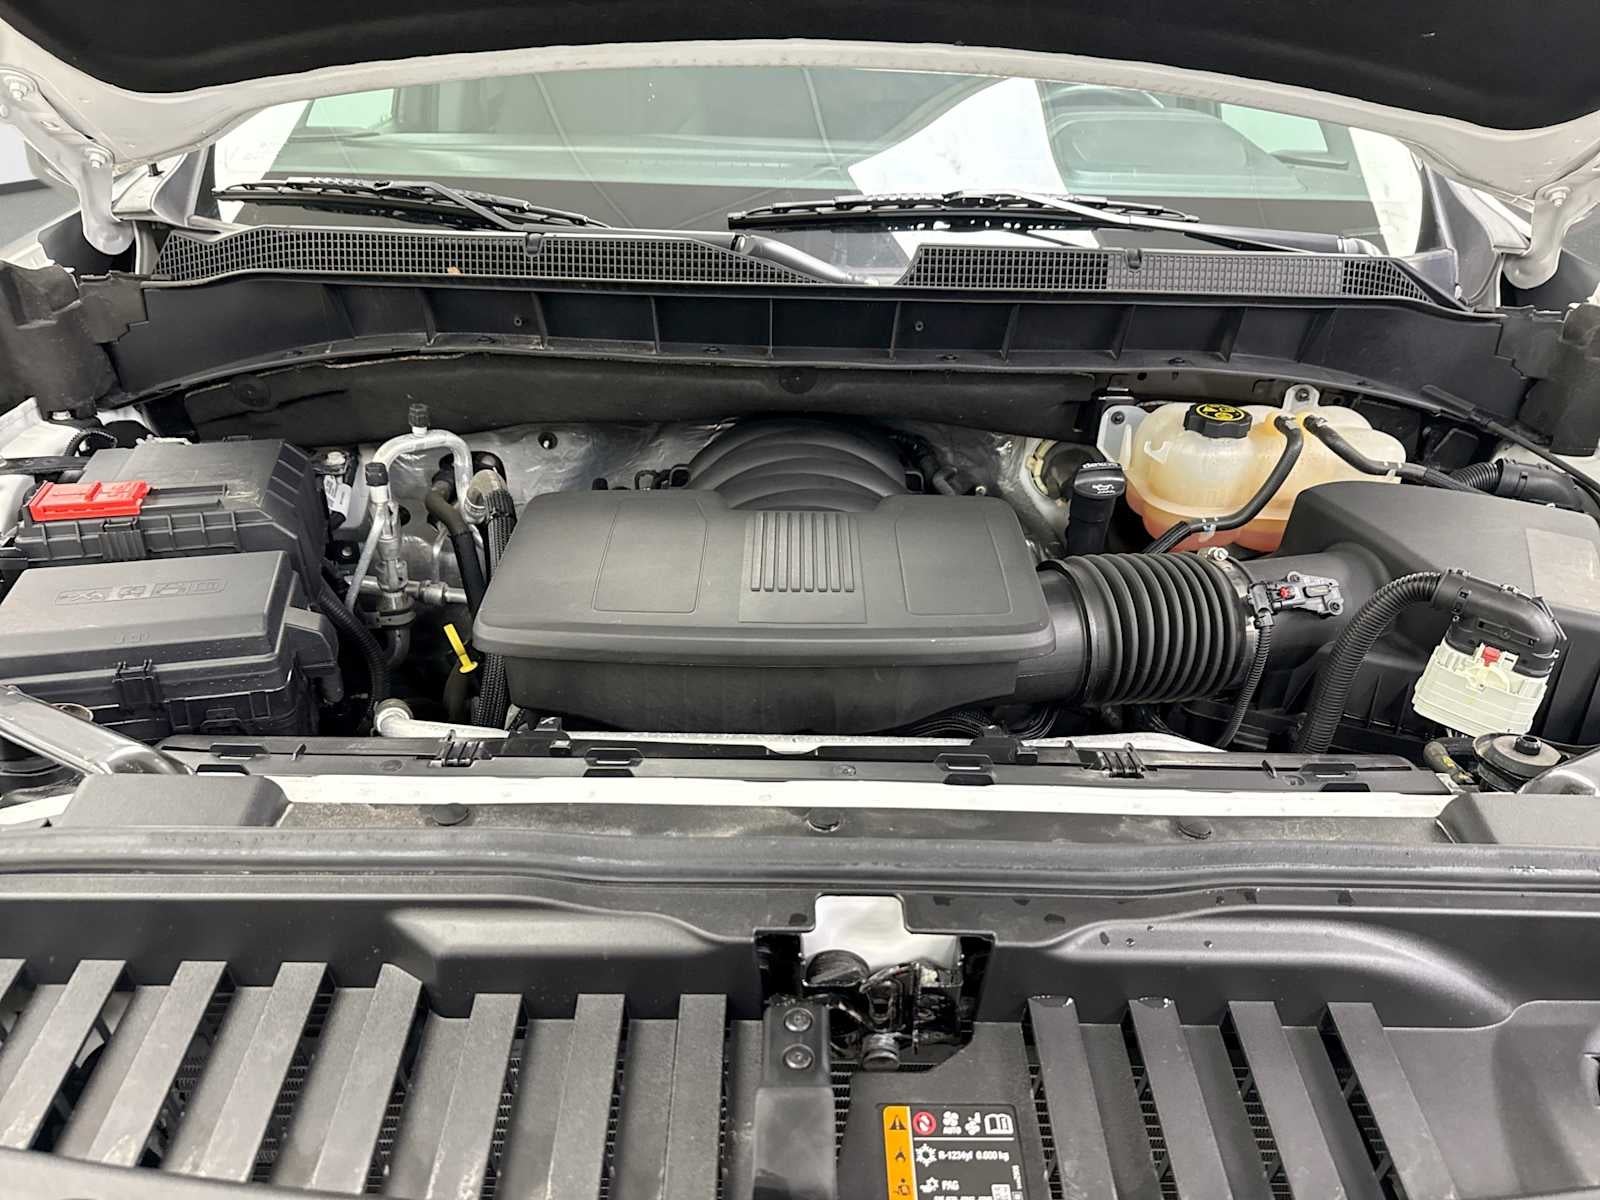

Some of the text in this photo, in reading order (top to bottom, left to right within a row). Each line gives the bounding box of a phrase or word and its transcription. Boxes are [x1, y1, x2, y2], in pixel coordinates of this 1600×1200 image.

[938, 1150, 973, 1162] R-1234yf
[998, 1150, 1010, 1162] kg
[941, 1180, 960, 1191] PAG
